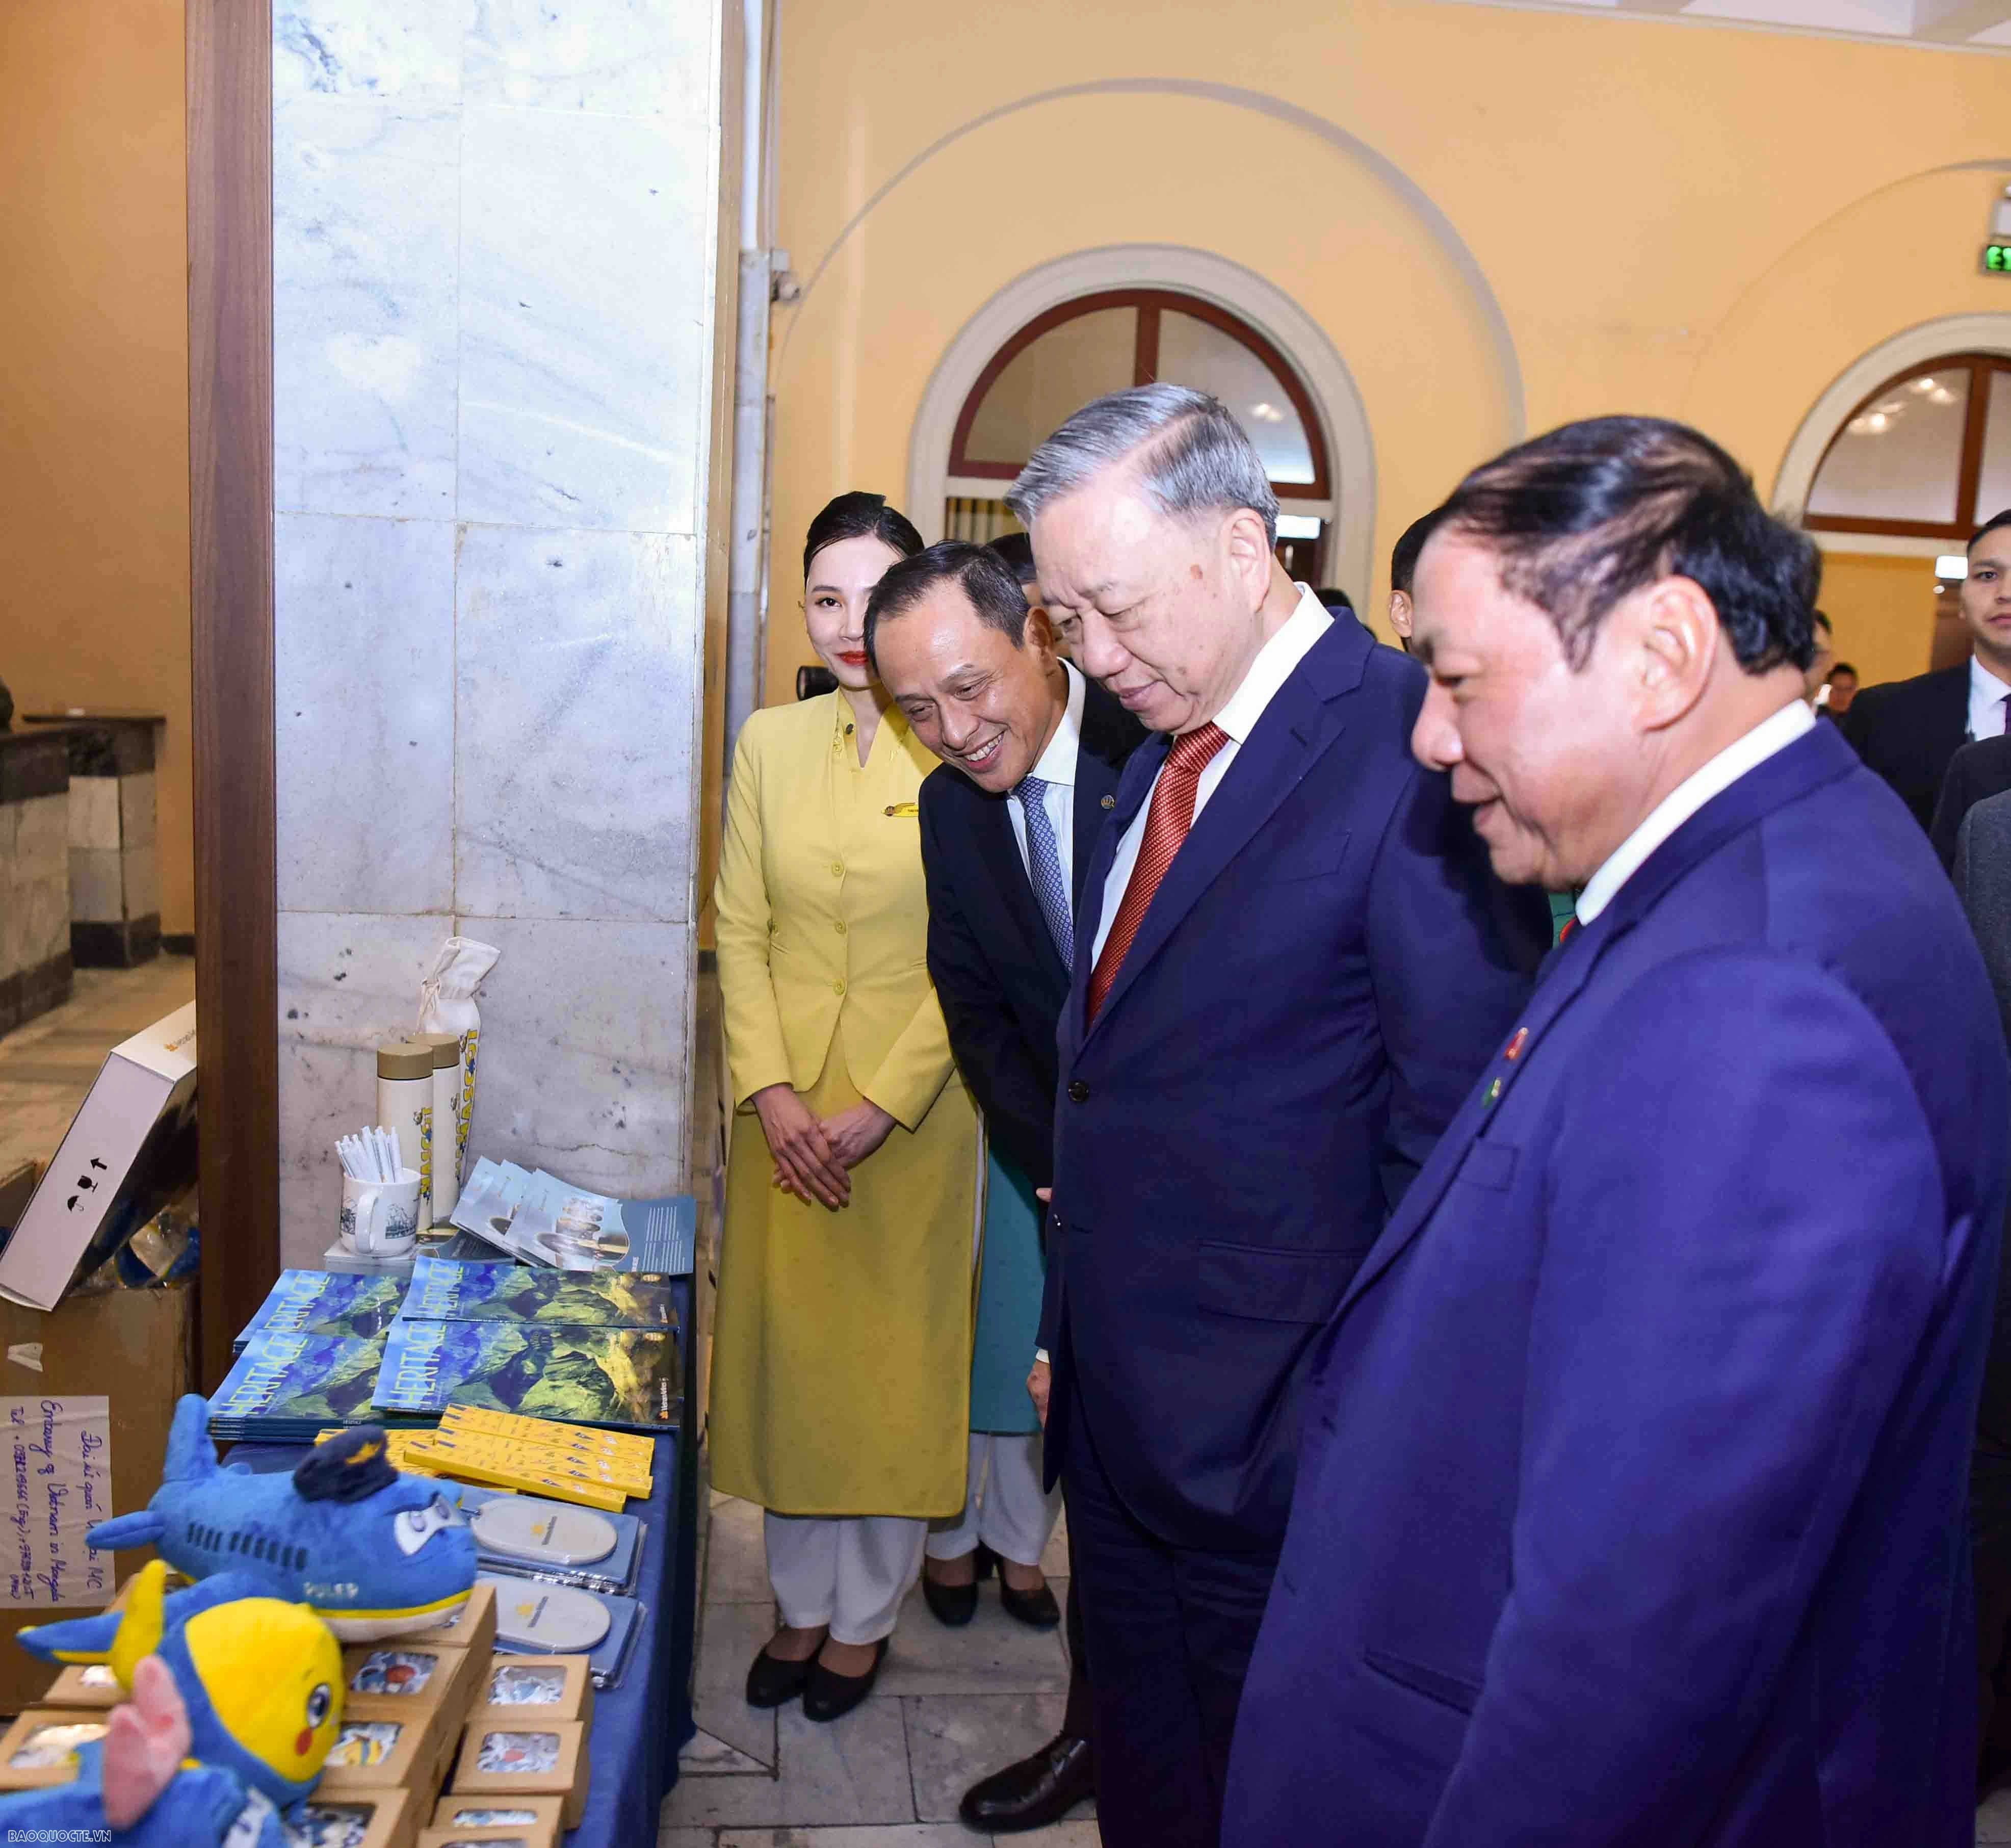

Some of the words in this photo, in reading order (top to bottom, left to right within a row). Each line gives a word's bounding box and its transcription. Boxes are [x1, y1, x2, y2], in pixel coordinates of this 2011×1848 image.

[415, 1263, 464, 1315] HERITAGE
[213, 1334, 309, 1416] HERITAGE
[386, 1323, 447, 1405] HERITAGE
